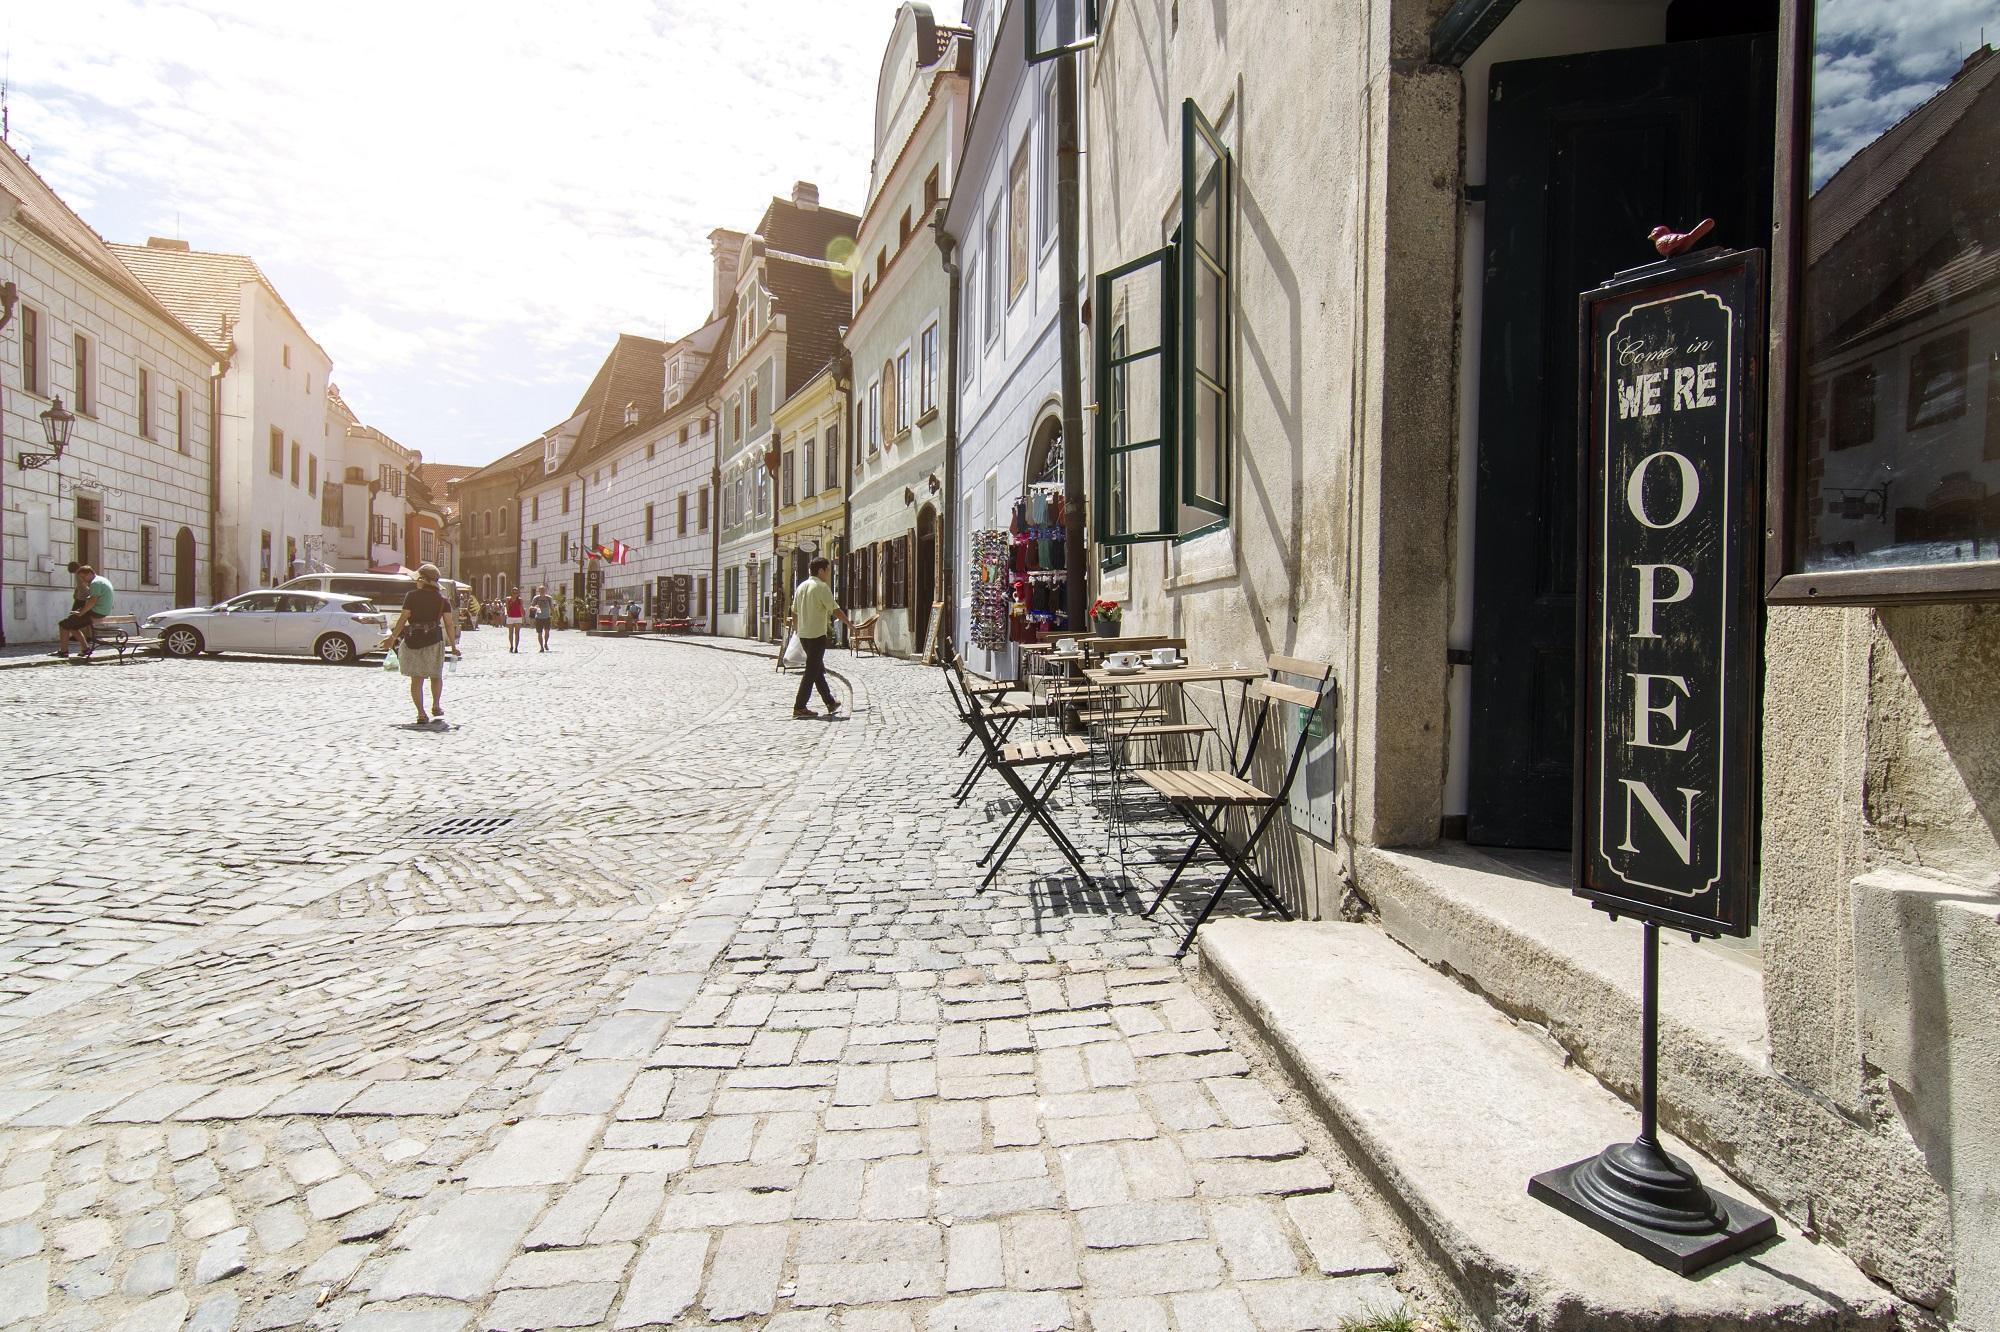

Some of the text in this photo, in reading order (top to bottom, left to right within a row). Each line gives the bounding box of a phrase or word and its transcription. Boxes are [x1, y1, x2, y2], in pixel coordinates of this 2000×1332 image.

[1617, 335, 1713, 366] Come in
[1618, 362, 1718, 420] WE'RE
[675, 577, 686, 613] café
[1618, 451, 1702, 866] OPEN
